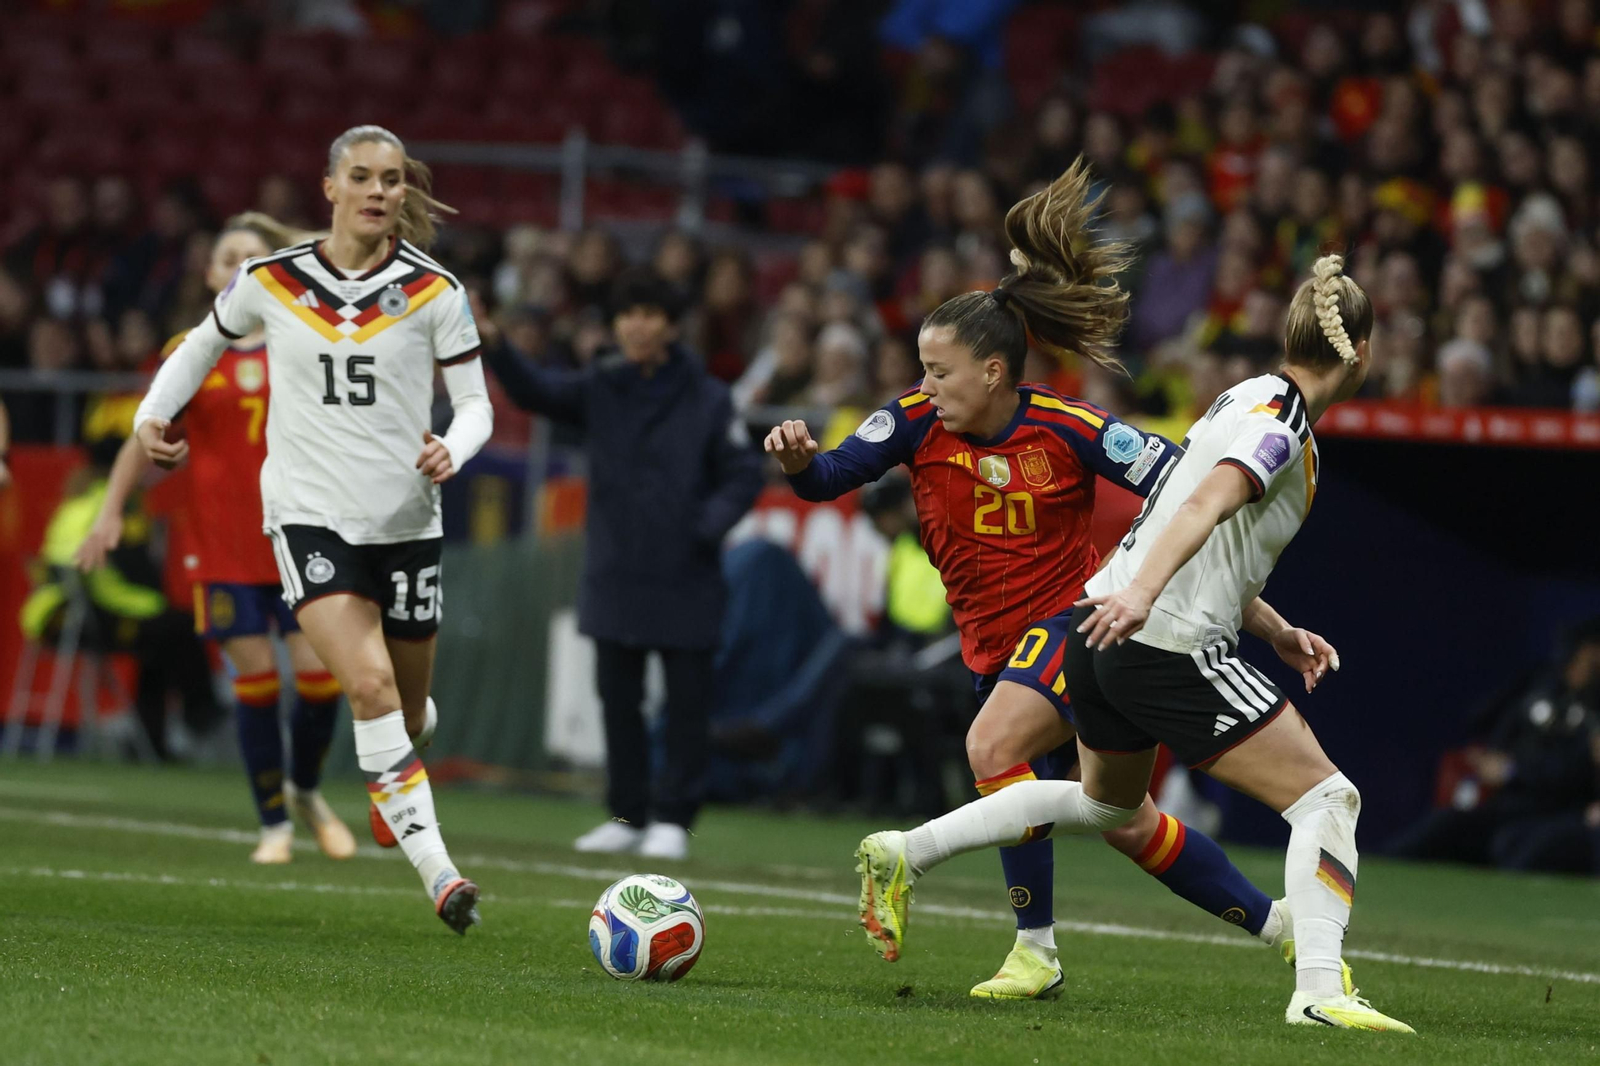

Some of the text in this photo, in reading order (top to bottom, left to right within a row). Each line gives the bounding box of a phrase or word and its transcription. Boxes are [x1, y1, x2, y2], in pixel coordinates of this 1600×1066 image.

[319, 354, 376, 406] 15
[239, 397, 265, 445] 7
[974, 484, 1036, 536] 20
[388, 565, 437, 621] 15
[1008, 627, 1049, 669] 0
[391, 806, 417, 824] DFB
